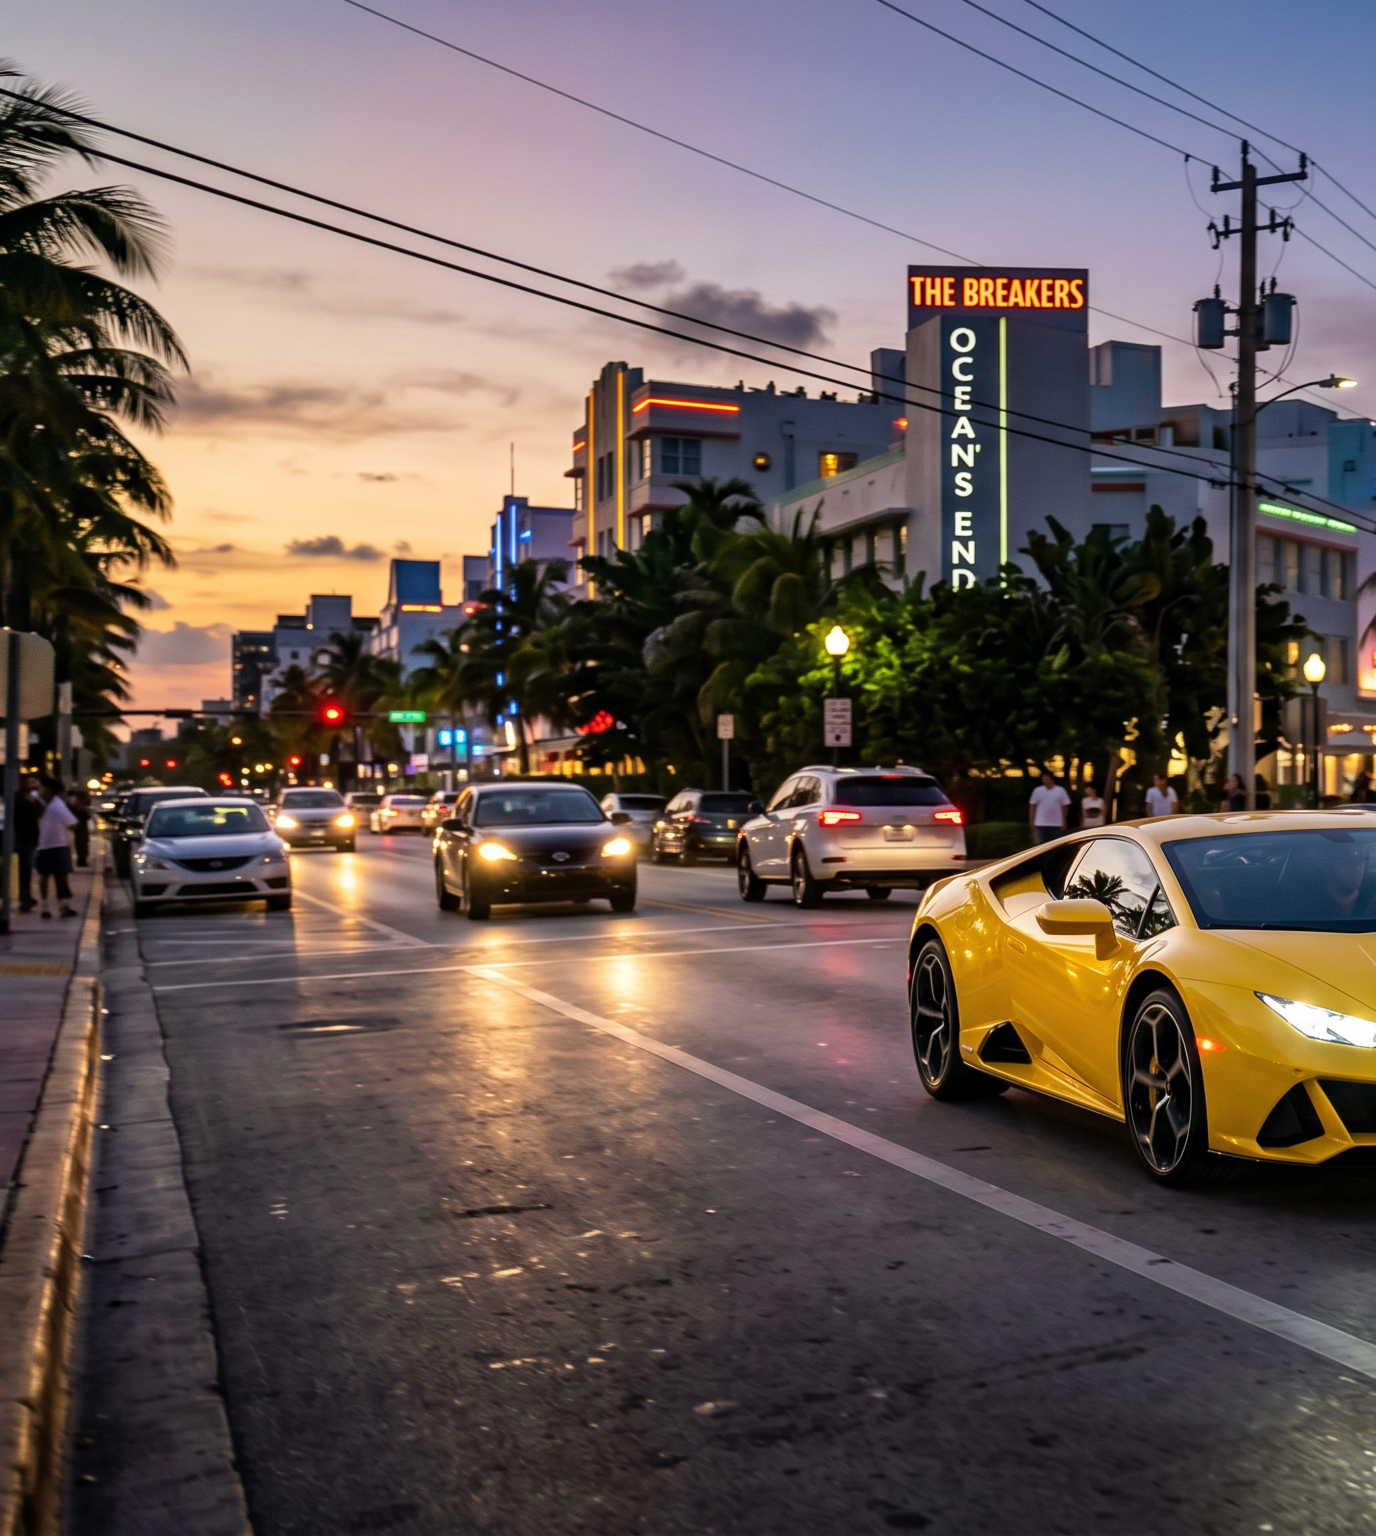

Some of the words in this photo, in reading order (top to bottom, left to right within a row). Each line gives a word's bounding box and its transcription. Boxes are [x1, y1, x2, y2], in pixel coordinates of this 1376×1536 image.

[911, 276, 956, 307] THE
[963, 278, 1084, 309] BREAKERS
[950, 327, 981, 498] OCEAN'S
[952, 511, 976, 593] END
